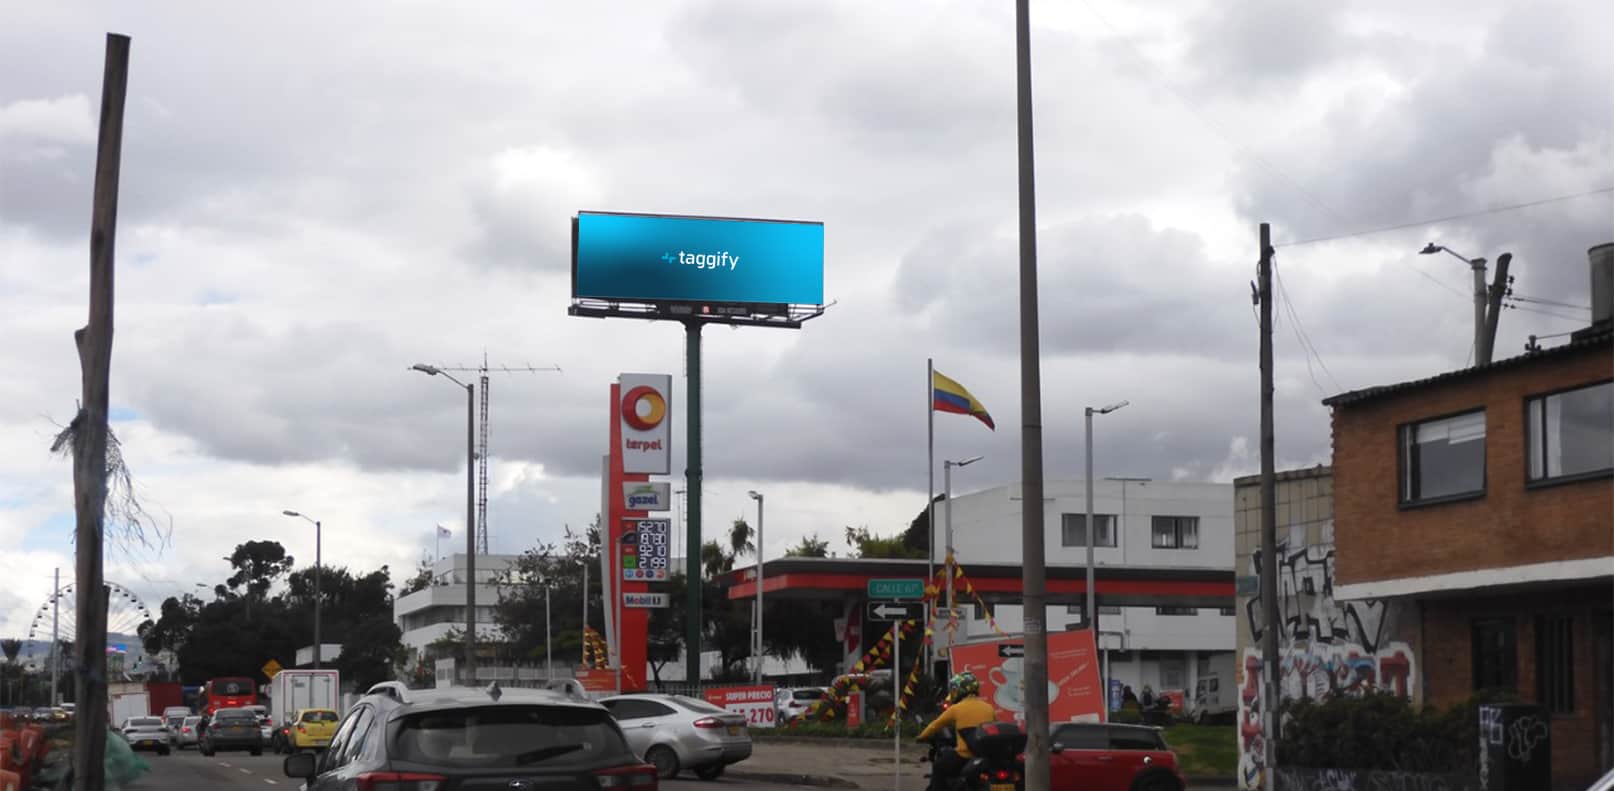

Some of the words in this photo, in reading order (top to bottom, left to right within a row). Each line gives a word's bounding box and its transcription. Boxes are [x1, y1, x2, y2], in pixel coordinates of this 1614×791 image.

[678, 250, 739, 271] taggify
[626, 439, 663, 453] terpel
[629, 495, 659, 509] gazel
